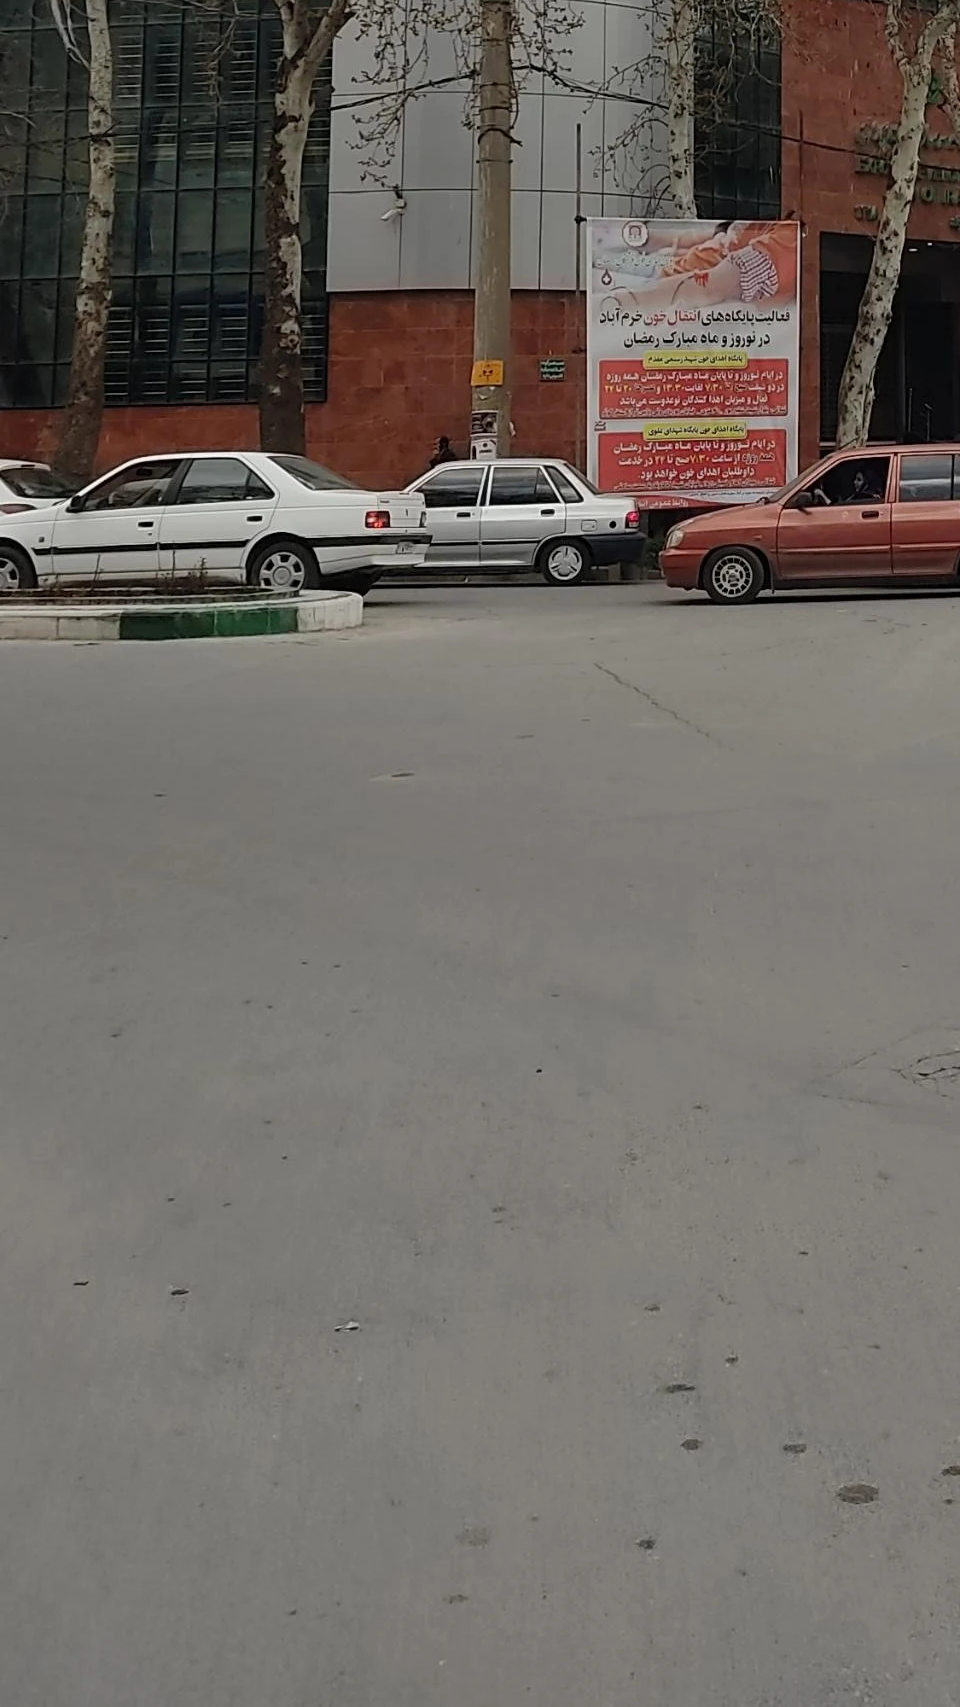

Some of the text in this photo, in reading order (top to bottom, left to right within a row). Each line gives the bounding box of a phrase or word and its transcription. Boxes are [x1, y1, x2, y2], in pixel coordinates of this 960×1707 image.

[643, 310, 667, 326] خون
[668, 309, 701, 326] انتقال
[755, 309, 790, 326] فعالیت
[623, 331, 660, 349] رمضان
[662, 330, 698, 348] مبارک
[700, 330, 719, 344] ماه
[729, 330, 757, 348] نوروز
[758, 332, 771, 348] در
[641, 372, 666, 383] رمضان
[739, 370, 759, 381] نوروز
[774, 371, 783, 381] در
[776, 383, 785, 393] در
[613, 442, 642, 454] رمضان
[643, 442, 673, 453] مبارک
[767, 441, 776, 451] در
[618, 454, 643, 465] خدمت
[644, 456, 653, 467] در
